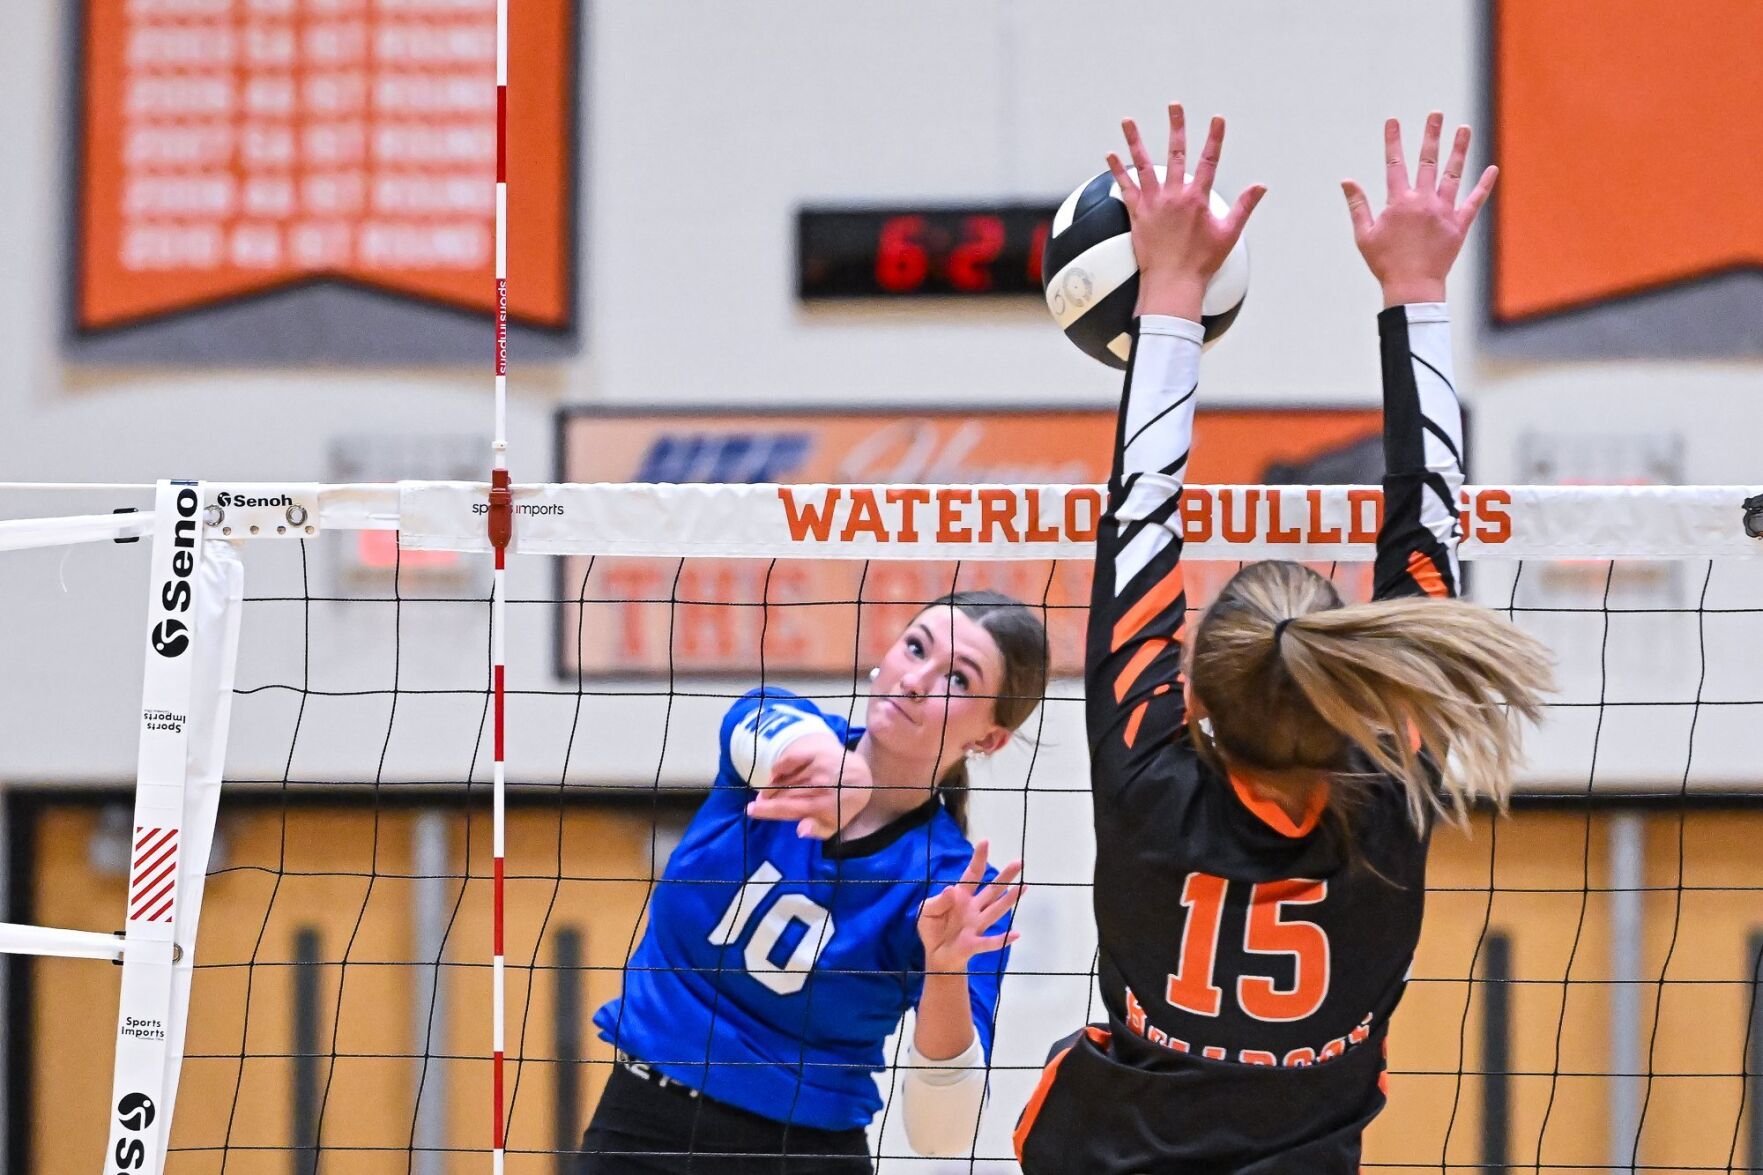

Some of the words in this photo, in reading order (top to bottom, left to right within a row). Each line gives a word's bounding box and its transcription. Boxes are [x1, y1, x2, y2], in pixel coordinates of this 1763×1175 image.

[233, 494, 293, 507] Senoh
[778, 487, 1110, 543] WATERLO
[1179, 488, 1511, 543] BULLDS
[162, 481, 199, 613] Seno
[144, 712, 186, 724] Imports
[147, 722, 181, 733] Sports
[707, 860, 836, 996] 10
[1165, 871, 1331, 1022] 15
[126, 1016, 161, 1028] Sports
[121, 1026, 165, 1038] Imports
